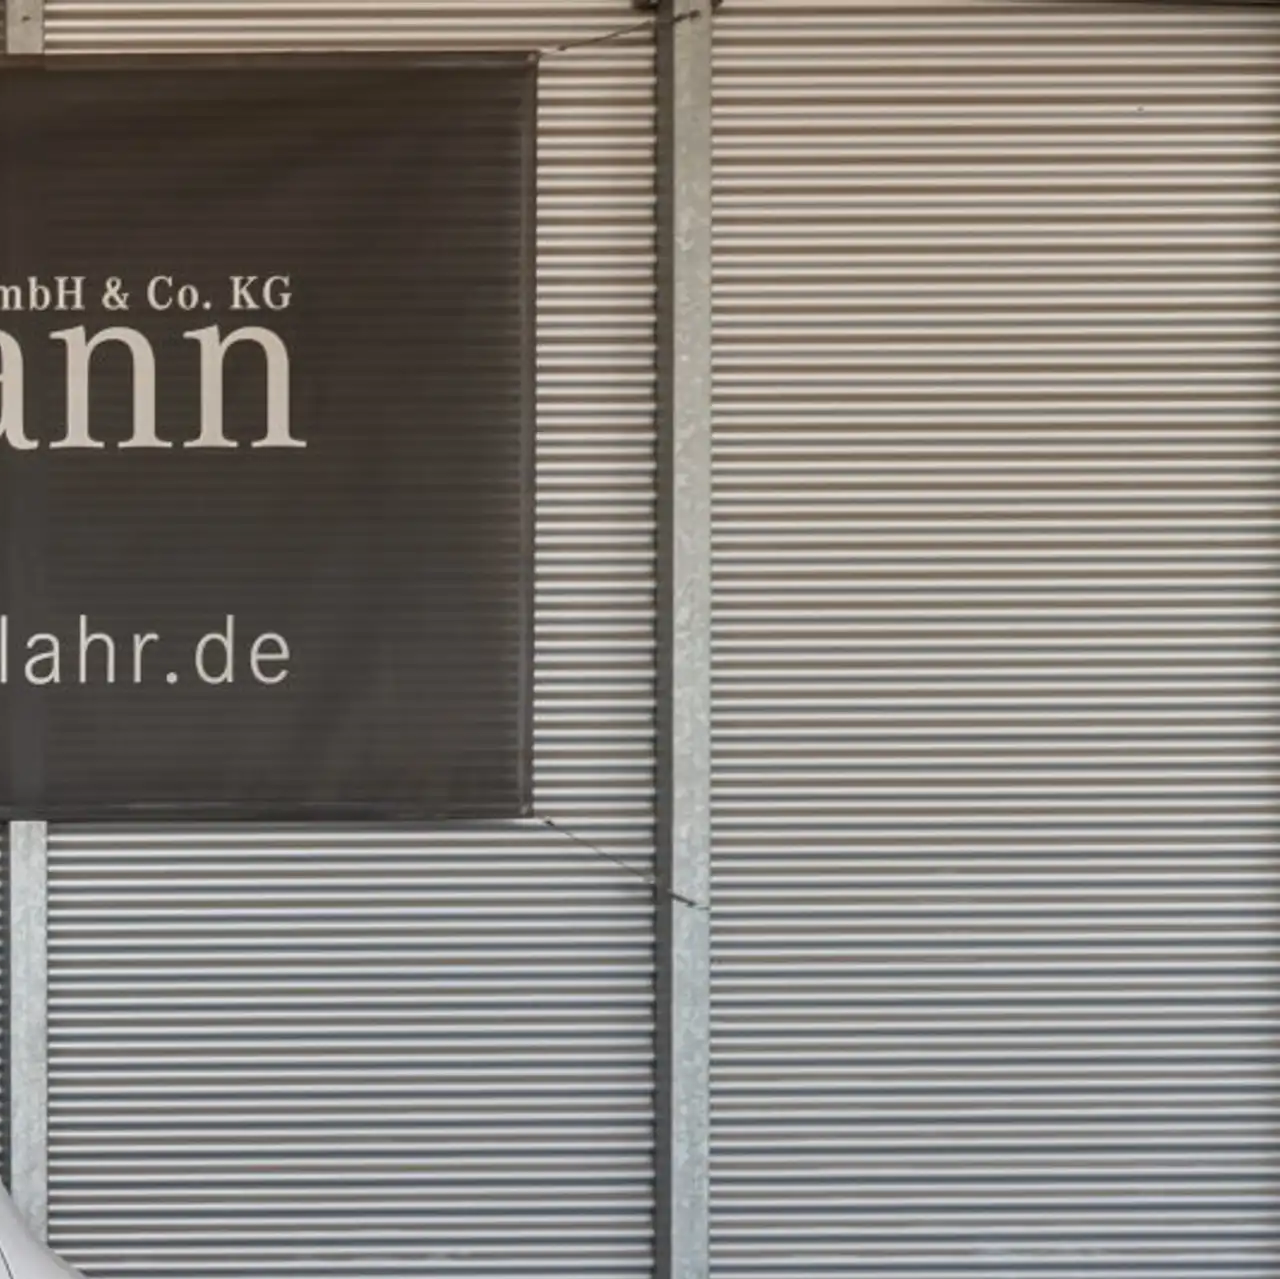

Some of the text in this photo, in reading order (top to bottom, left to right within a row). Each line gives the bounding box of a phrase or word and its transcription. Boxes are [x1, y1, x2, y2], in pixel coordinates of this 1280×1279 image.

[101, 277, 129, 310] &
[147, 275, 212, 311] Co.
[230, 275, 292, 310] KG
